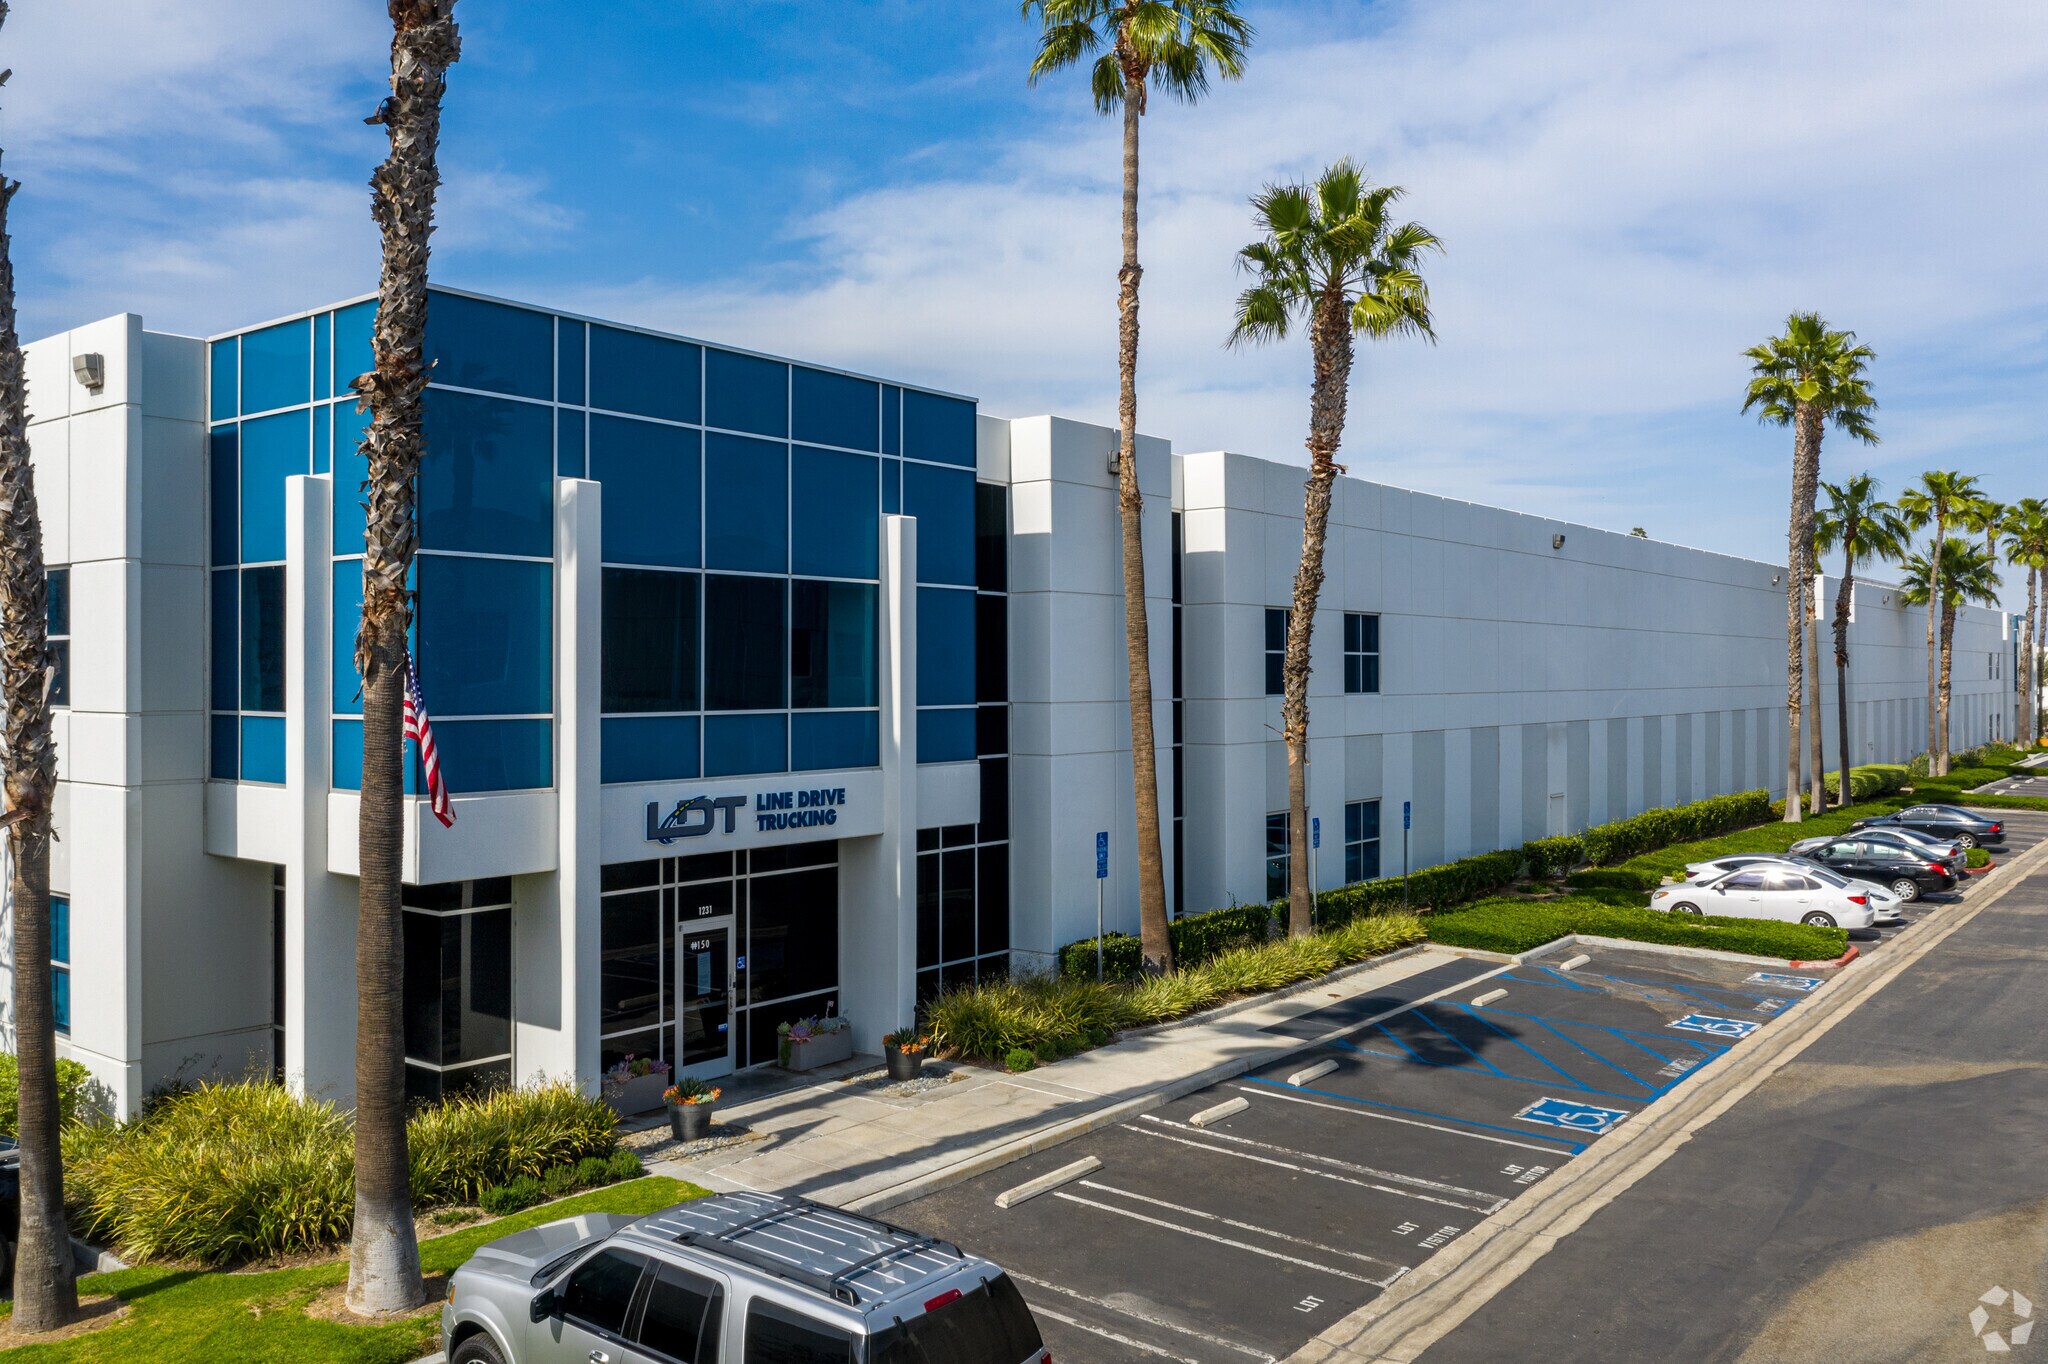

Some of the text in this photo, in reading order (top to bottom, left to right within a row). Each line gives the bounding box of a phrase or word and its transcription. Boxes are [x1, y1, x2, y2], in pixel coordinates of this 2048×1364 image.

[756, 788, 846, 811] LINE DRIVE
[646, 795, 747, 845] LDT
[757, 809, 837, 832] TRUCKING
[698, 905, 713, 916] 1231
[690, 939, 710, 950] #150
[1391, 1221, 1420, 1236] LDT
[1417, 1225, 1461, 1249] VISITOR
[1293, 1295, 1325, 1313] LDT
